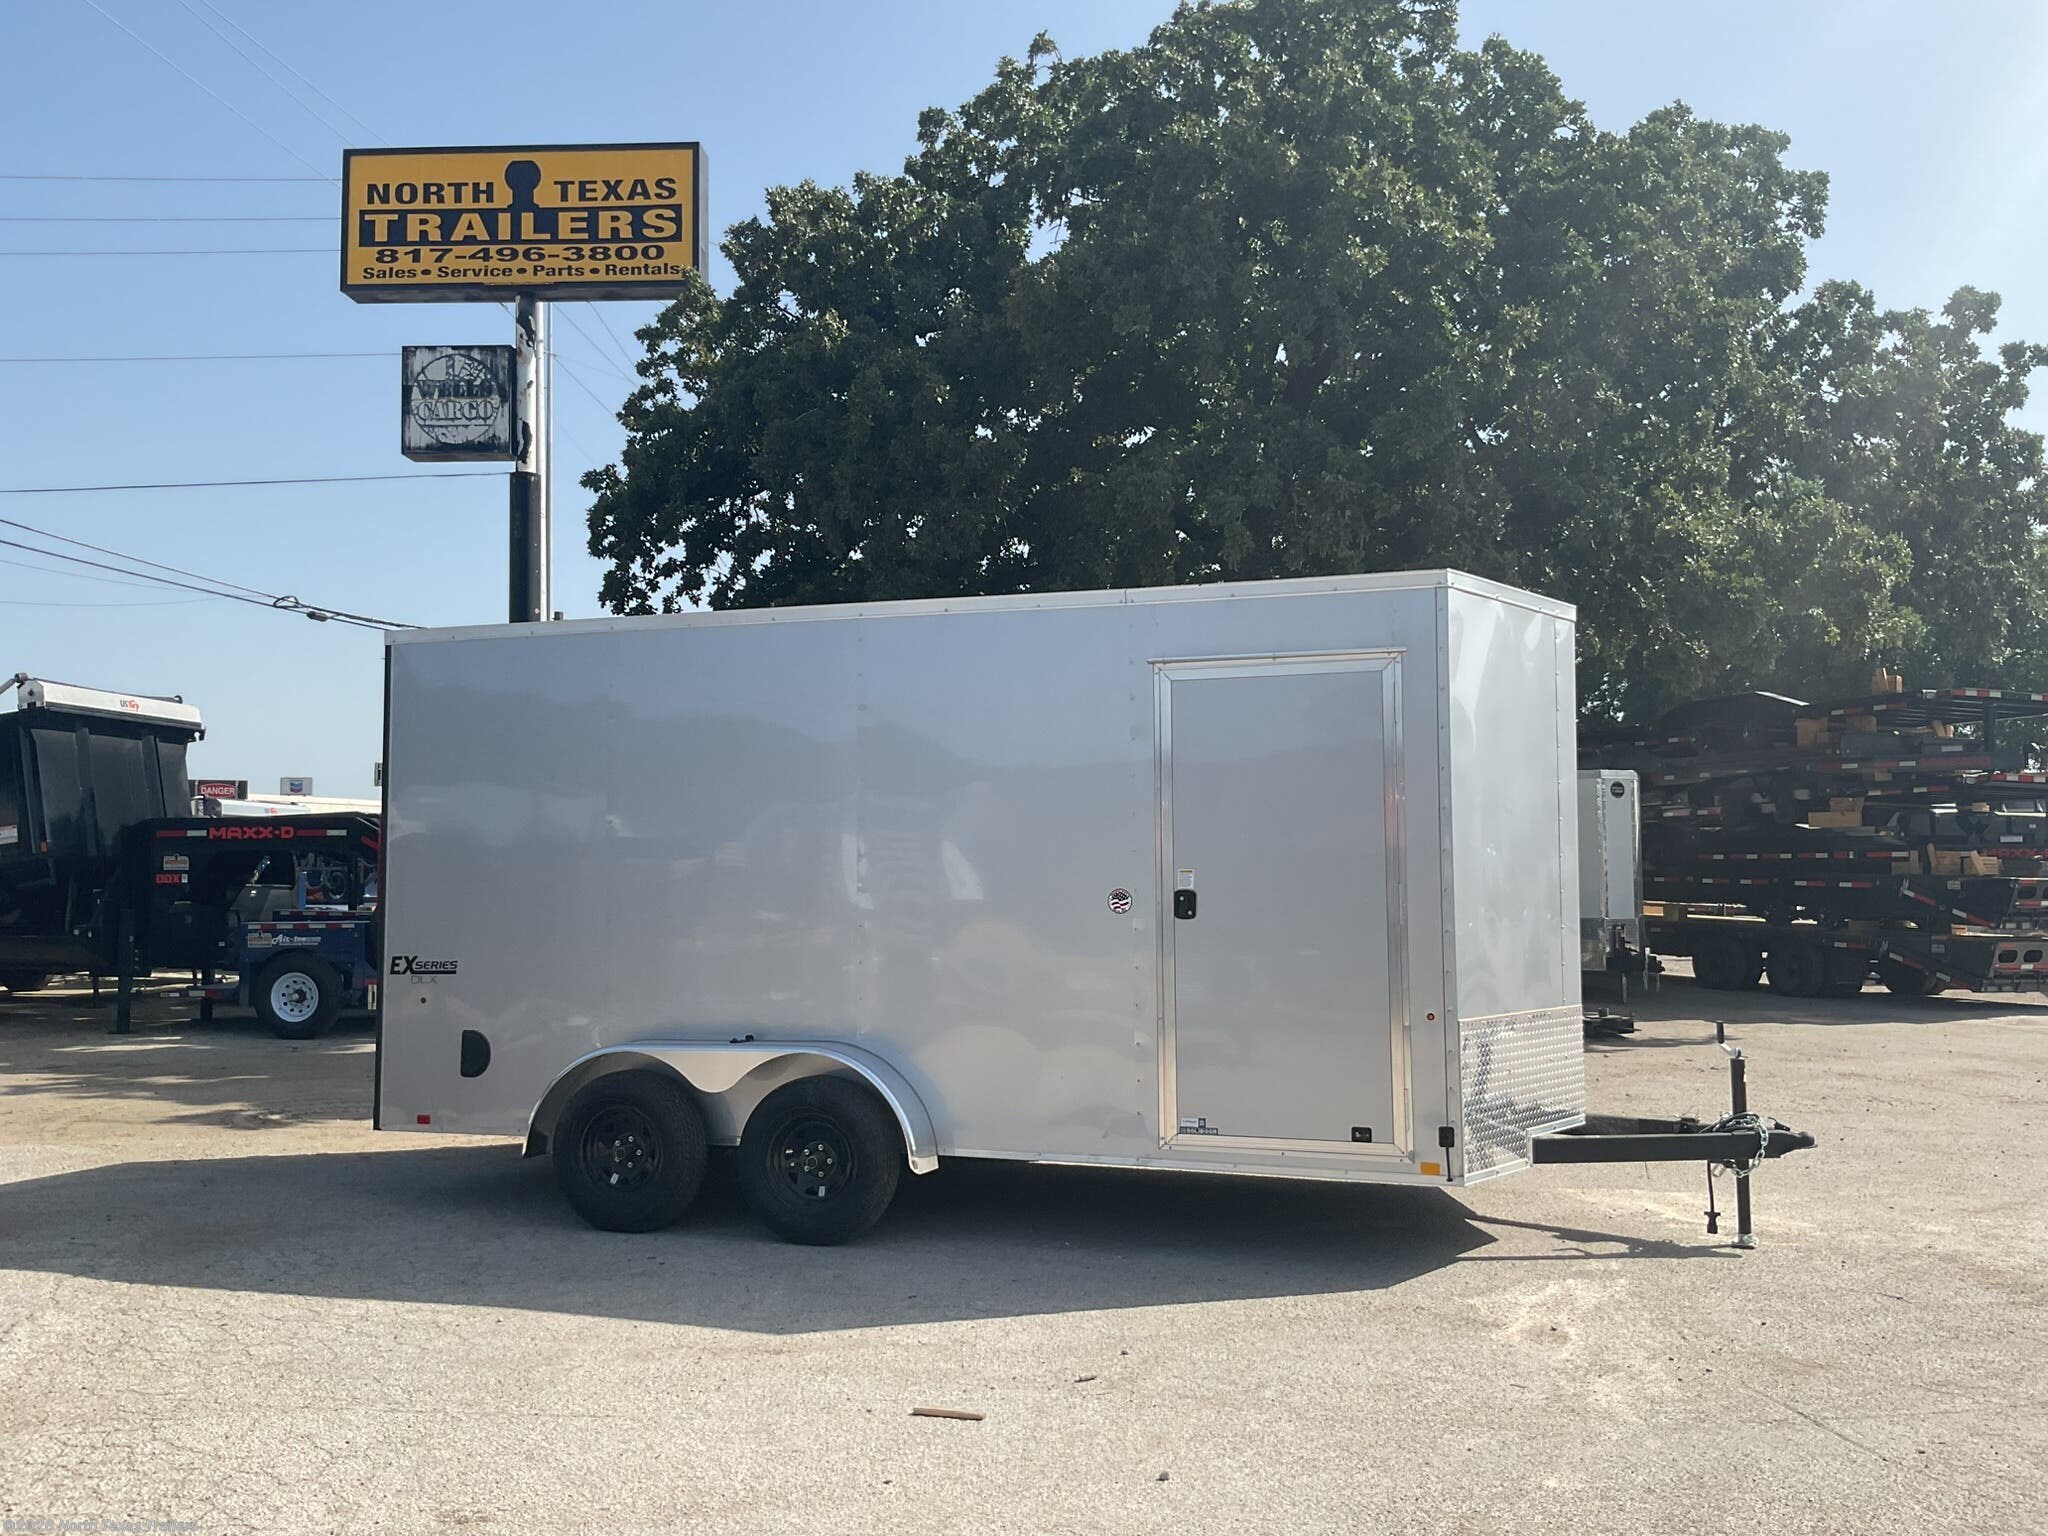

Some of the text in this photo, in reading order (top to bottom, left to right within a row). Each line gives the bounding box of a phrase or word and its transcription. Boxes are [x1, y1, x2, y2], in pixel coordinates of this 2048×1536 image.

[367, 177, 677, 205] NORTH TEXAS
[364, 209, 677, 242] TRAILERS
[375, 244, 665, 264] 817-496-3800
[362, 262, 680, 280] Sales Service Parts Rentals
[417, 400, 494, 421] CARGO
[200, 786, 236, 796] DANGER
[208, 826, 294, 839] MAXX-D
